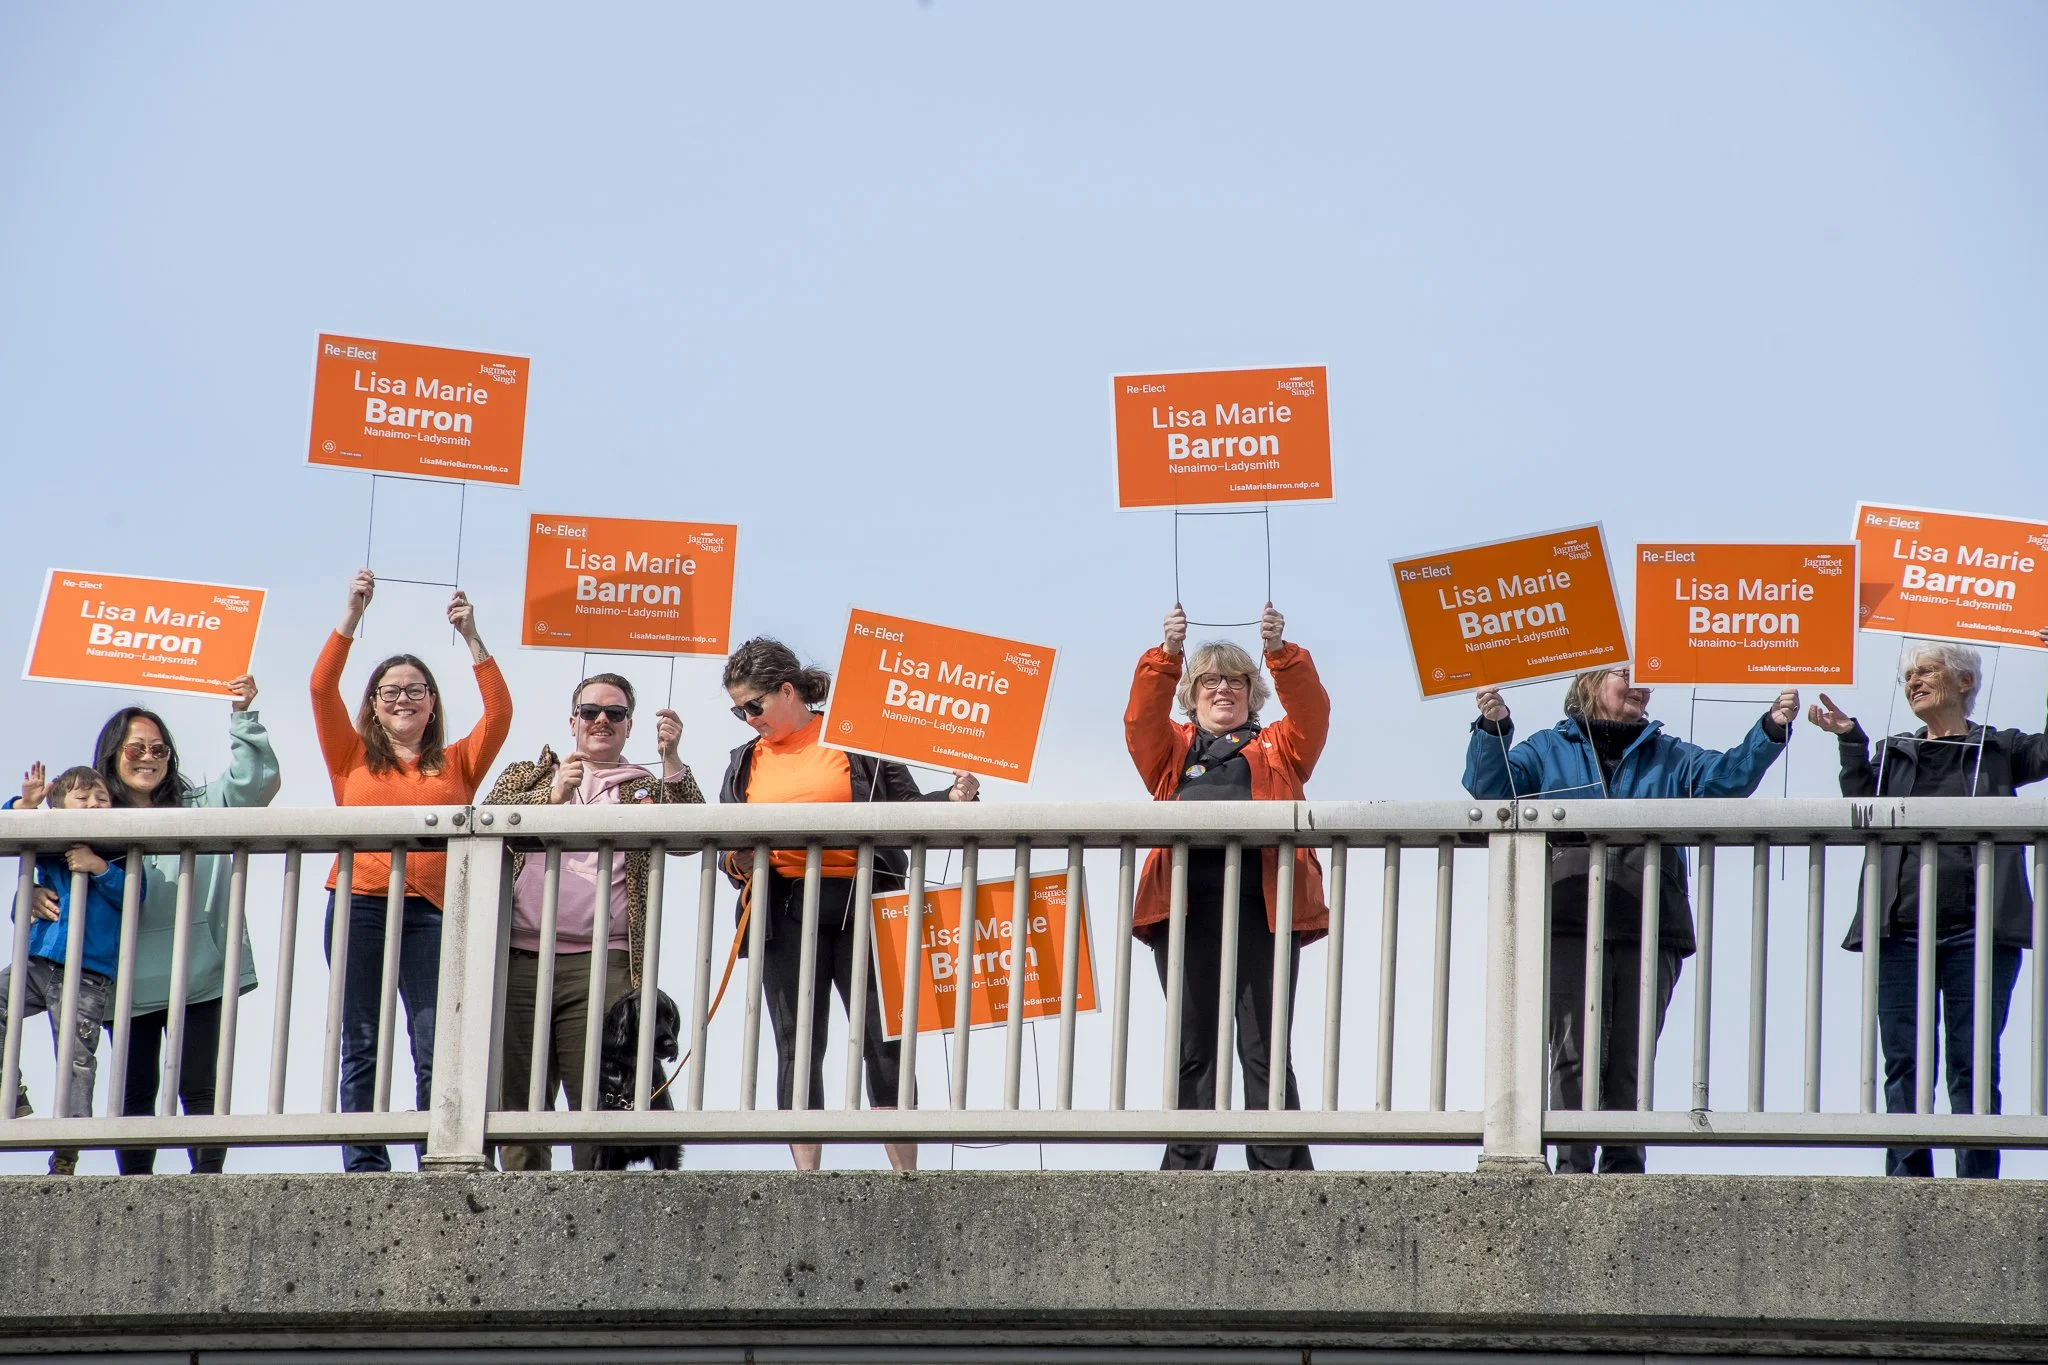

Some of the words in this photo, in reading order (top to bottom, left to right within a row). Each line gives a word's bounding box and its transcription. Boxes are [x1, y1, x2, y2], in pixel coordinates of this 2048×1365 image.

[324, 343, 377, 361] Re-Elect
[478, 364, 517, 377] Jagmeet
[493, 374, 516, 384] Singh
[1276, 379, 1314, 391] Jagmeet
[354, 370, 406, 396] Lisa
[416, 377, 488, 405] Marie
[1127, 384, 1166, 393] Re-Elect
[1291, 388, 1314, 397] Singh
[365, 397, 472, 433] Barron
[1152, 406, 1206, 429] Lisa
[1215, 401, 1292, 426] Marie
[1167, 433, 1279, 460] Barron
[420, 457, 509, 473] LisaMarieBarron.ndp.ca
[1230, 481, 1319, 491] LisaMarieBarron.ndp.ca
[1866, 514, 1920, 530] Re-Elect
[536, 523, 586, 538] Re-Elect
[687, 534, 724, 545] Jagmeet
[701, 543, 723, 553] Singh
[1553, 542, 1590, 556] Jagmeet
[1569, 550, 1592, 561] Singh
[1642, 550, 1695, 562] Re-Elect
[1893, 539, 1949, 563] Lisa
[1956, 545, 2035, 572] Marie
[565, 548, 615, 571] Lisa
[625, 551, 696, 575] Marie
[1803, 558, 1842, 568] Jagmeet
[1401, 565, 1452, 581] Re-Elect
[1818, 566, 1842, 576] Singh
[62, 579, 102, 589] Re-Elect
[1439, 586, 1492, 610] Lisa
[1497, 569, 1571, 599] Marie
[1675, 578, 1729, 601] Lisa
[1738, 578, 1814, 601] Marie
[1902, 564, 2016, 599] Barron
[576, 575, 680, 605] Barron
[211, 596, 250, 606] Jagmeet
[225, 603, 249, 613] Singh
[80, 600, 134, 622] Lisa
[144, 606, 221, 630] Marie
[1458, 602, 1566, 639] Barron
[1689, 607, 1799, 634] Barron
[89, 623, 201, 655] Barron
[630, 632, 716, 643] LisaMarieBarron.ndp.ca
[853, 623, 904, 643] Re-Elect
[1003, 652, 1040, 668] Jagmeet
[1527, 645, 1614, 666] LisaMarieBarron.ndp.ca
[879, 649, 930, 679] Lisa
[937, 661, 1009, 695] Marie
[1016, 663, 1039, 676] Singh
[1748, 665, 1840, 673] LisaMarieBarron.ndp.ca
[885, 679, 990, 724] Barron
[932, 746, 1019, 769] LisaMarieBarron.ndp.ca
[1033, 887, 1066, 901] Jagmee
[1048, 896, 1066, 906] Sing
